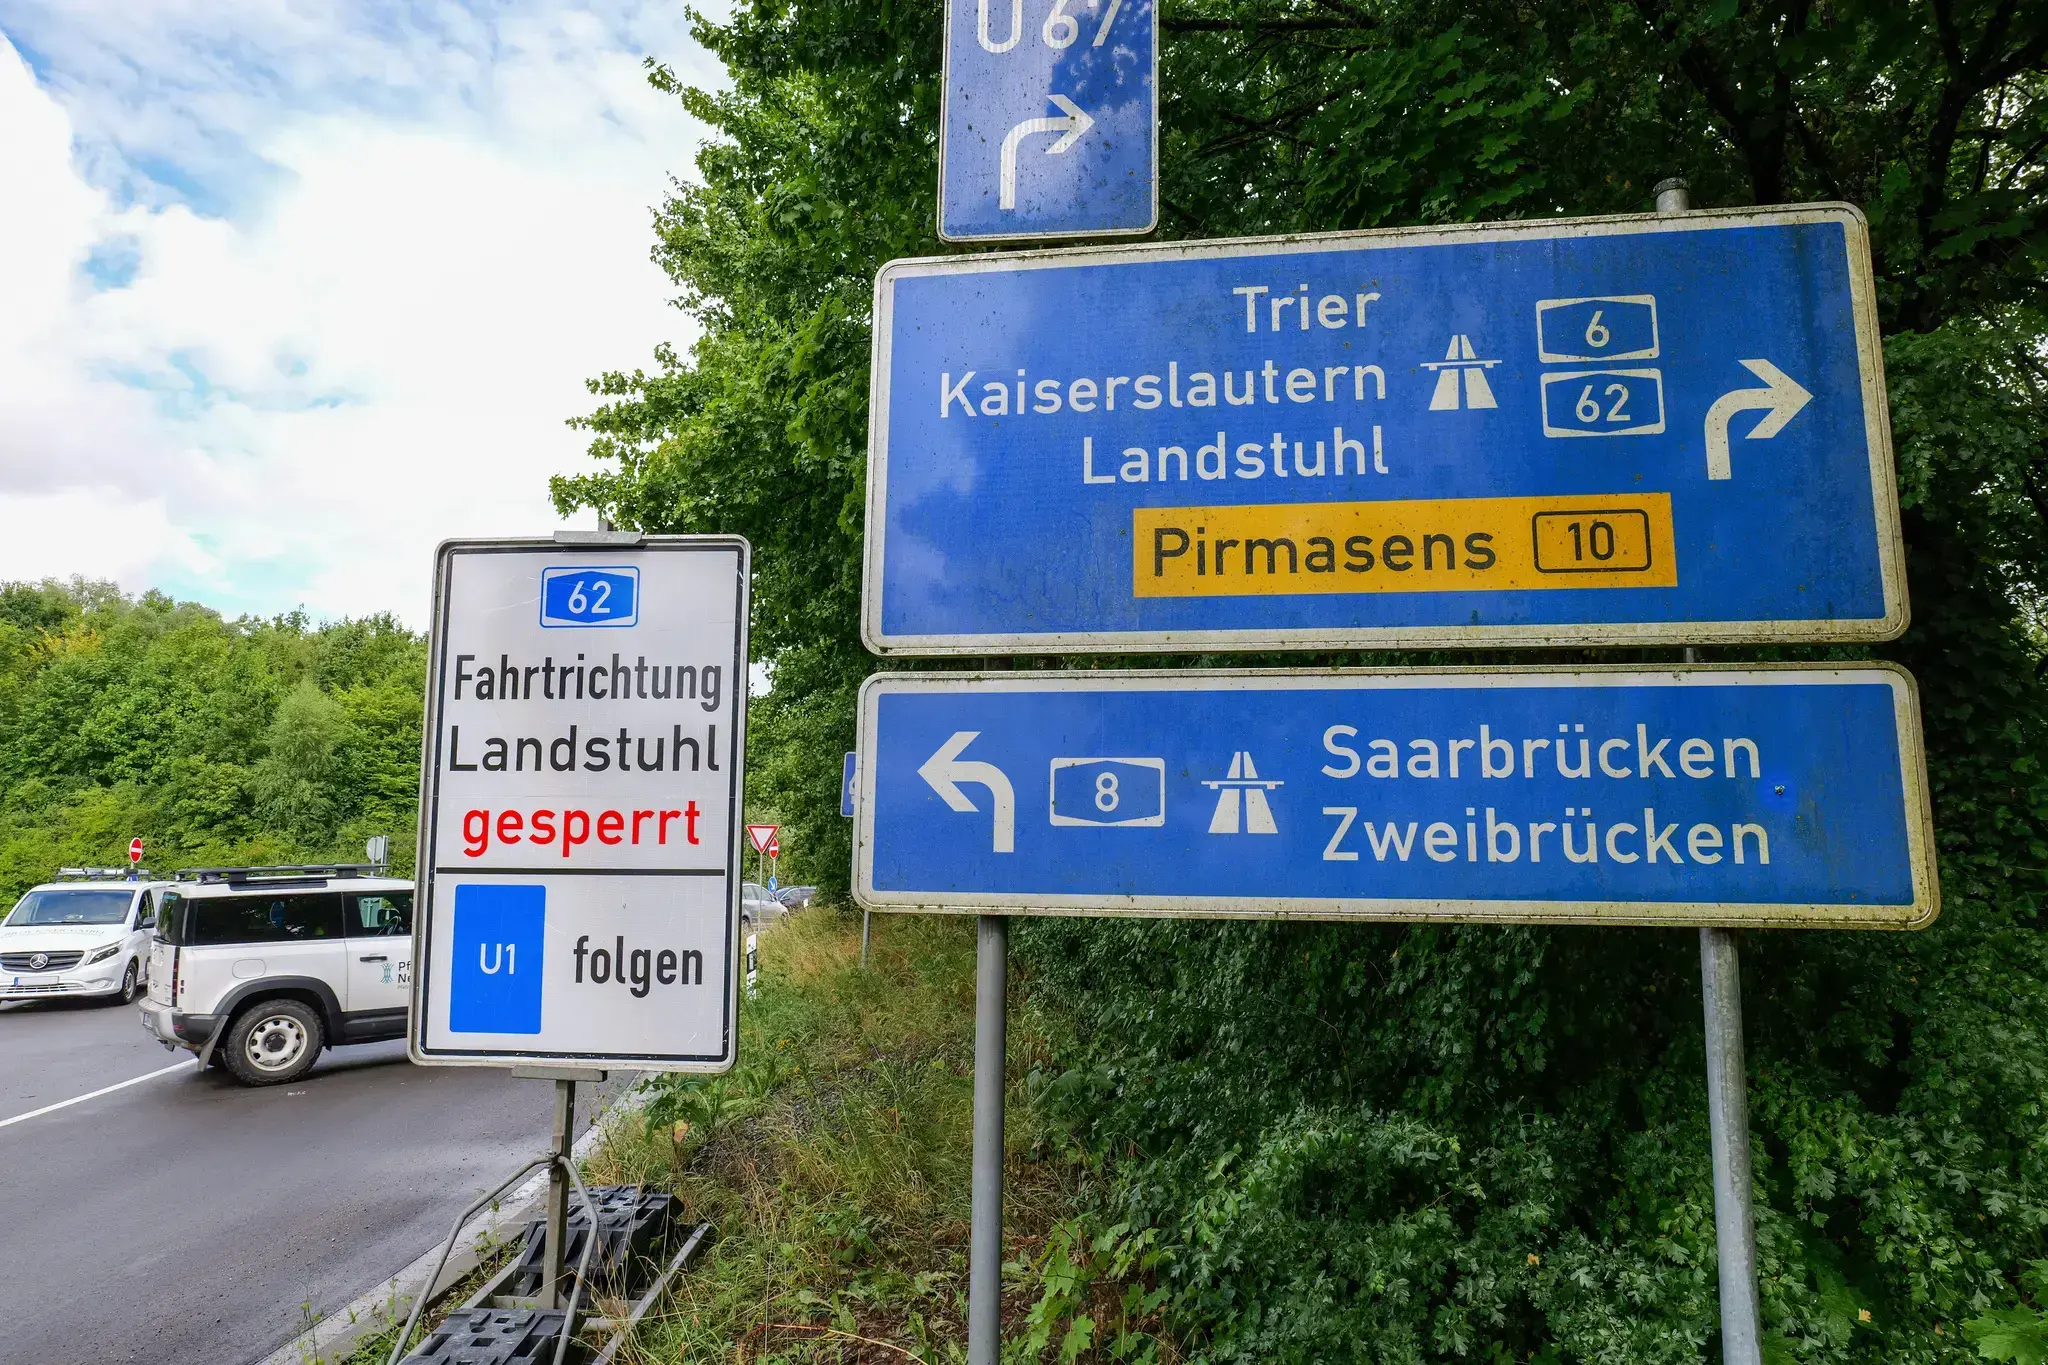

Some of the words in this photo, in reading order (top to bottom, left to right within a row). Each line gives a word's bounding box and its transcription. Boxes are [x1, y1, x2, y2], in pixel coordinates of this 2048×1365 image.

[977, 0, 1023, 54] U
[1232, 283, 1382, 333] Trier
[1585, 311, 1610, 348] 6
[940, 359, 1386, 418] Kaiserslautern
[1575, 383, 1631, 423] 62
[1083, 425, 1389, 484] Landstuhl
[1154, 526, 1497, 577] Pirmasens
[1567, 521, 1615, 561] 10
[568, 580, 612, 614] 62
[455, 653, 721, 713] Fahrtrichtung
[449, 724, 720, 772] Landstuhl
[1321, 723, 1761, 779] Saarbrücken
[1094, 772, 1120, 812] 8
[463, 800, 700, 858] gesperrt
[1322, 806, 1770, 865] Zweibrücken
[480, 943, 516, 975] U1
[573, 935, 703, 998] folgen
